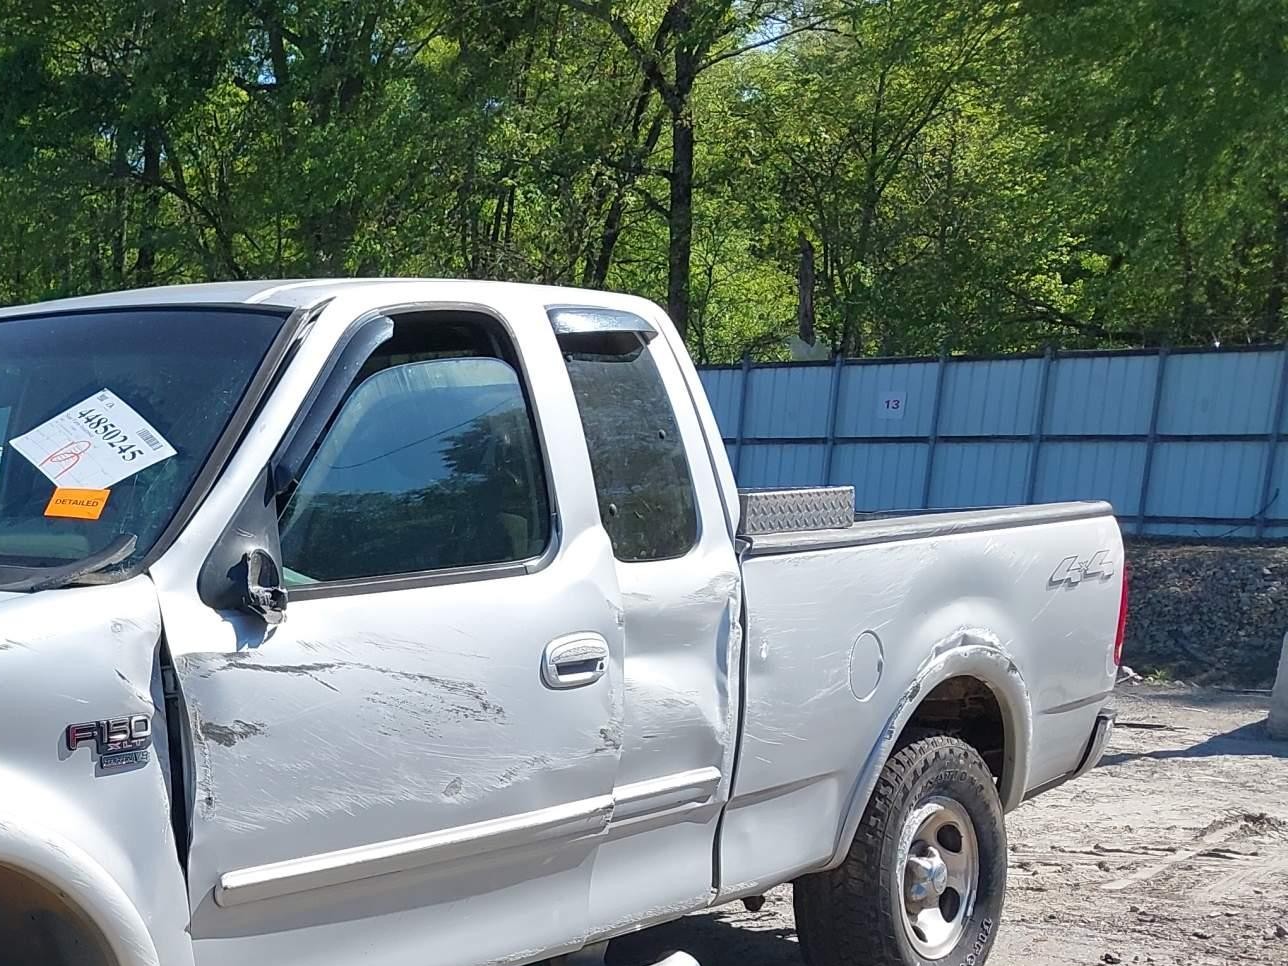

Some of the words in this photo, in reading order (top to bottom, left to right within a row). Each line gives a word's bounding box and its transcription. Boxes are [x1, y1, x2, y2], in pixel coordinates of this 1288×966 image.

[884, 399, 900, 410] 13
[77, 408, 145, 462] 44850245
[54, 497, 99, 508] DETAILED
[107, 738, 146, 752] XLT
